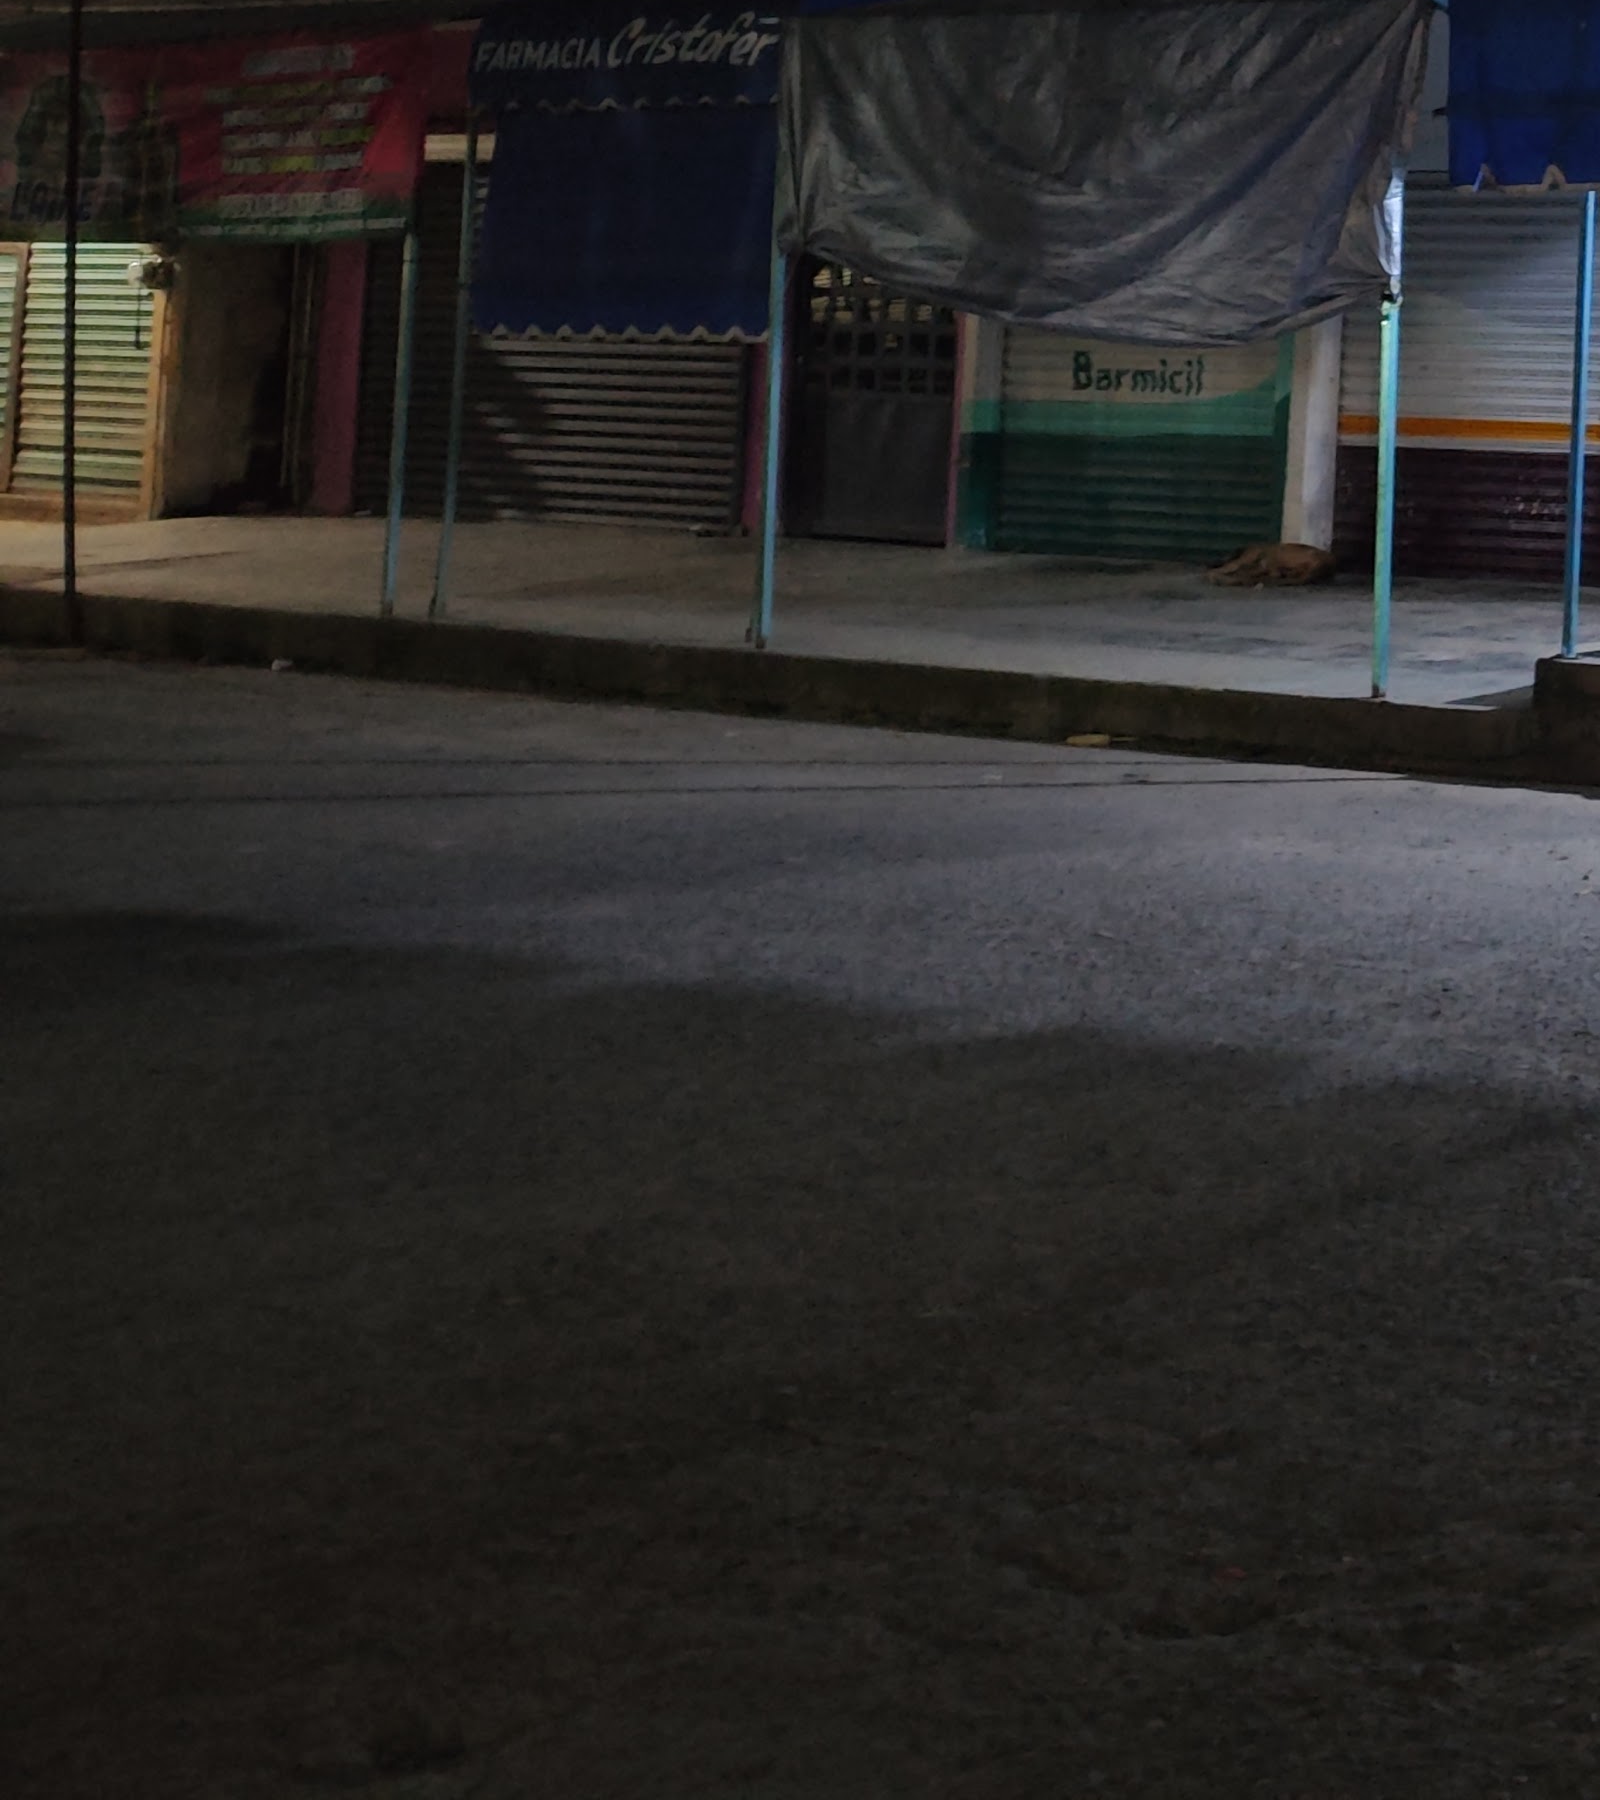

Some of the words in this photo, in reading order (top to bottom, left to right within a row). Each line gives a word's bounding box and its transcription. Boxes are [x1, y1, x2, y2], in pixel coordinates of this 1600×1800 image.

[473, 36, 600, 73] FARMACIA
[606, 10, 780, 68] Cristofer
[1072, 349, 1205, 396] Barmicil
